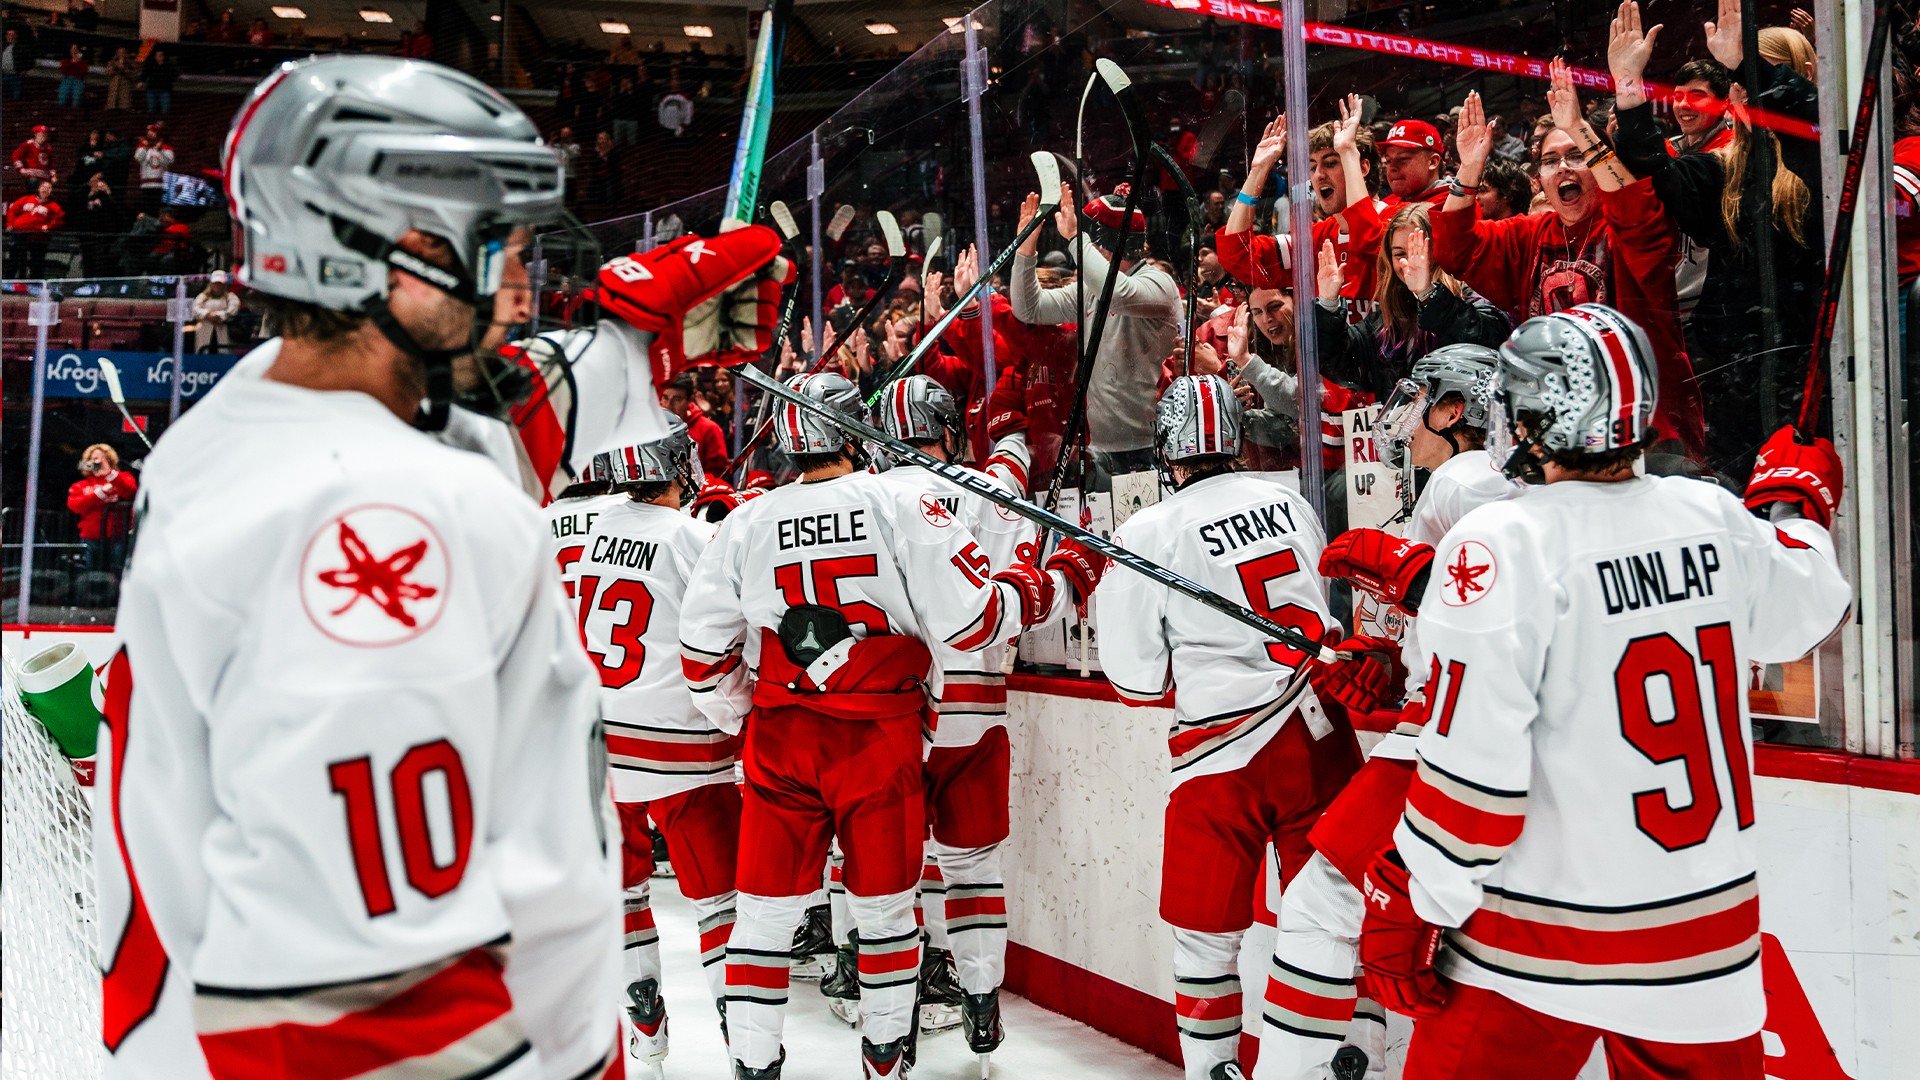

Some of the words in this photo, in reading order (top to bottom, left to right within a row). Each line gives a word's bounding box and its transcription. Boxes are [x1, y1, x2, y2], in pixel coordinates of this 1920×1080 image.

[47, 353, 122, 394] Kroge
[626, 464, 642, 479] 13
[1354, 472, 1376, 496] UP
[591, 535, 659, 571] CARON
[778, 509, 867, 551] EISELE
[1200, 502, 1297, 557] STRAKY
[950, 540, 991, 590] 15
[1595, 543, 1721, 616] DUNLAP
[773, 553, 892, 637] 15
[1235, 547, 1326, 672] 5
[578, 574, 655, 690] 13
[1249, 612, 1286, 635] BAUER
[1614, 620, 1755, 853] 91
[328, 738, 474, 918] 10
